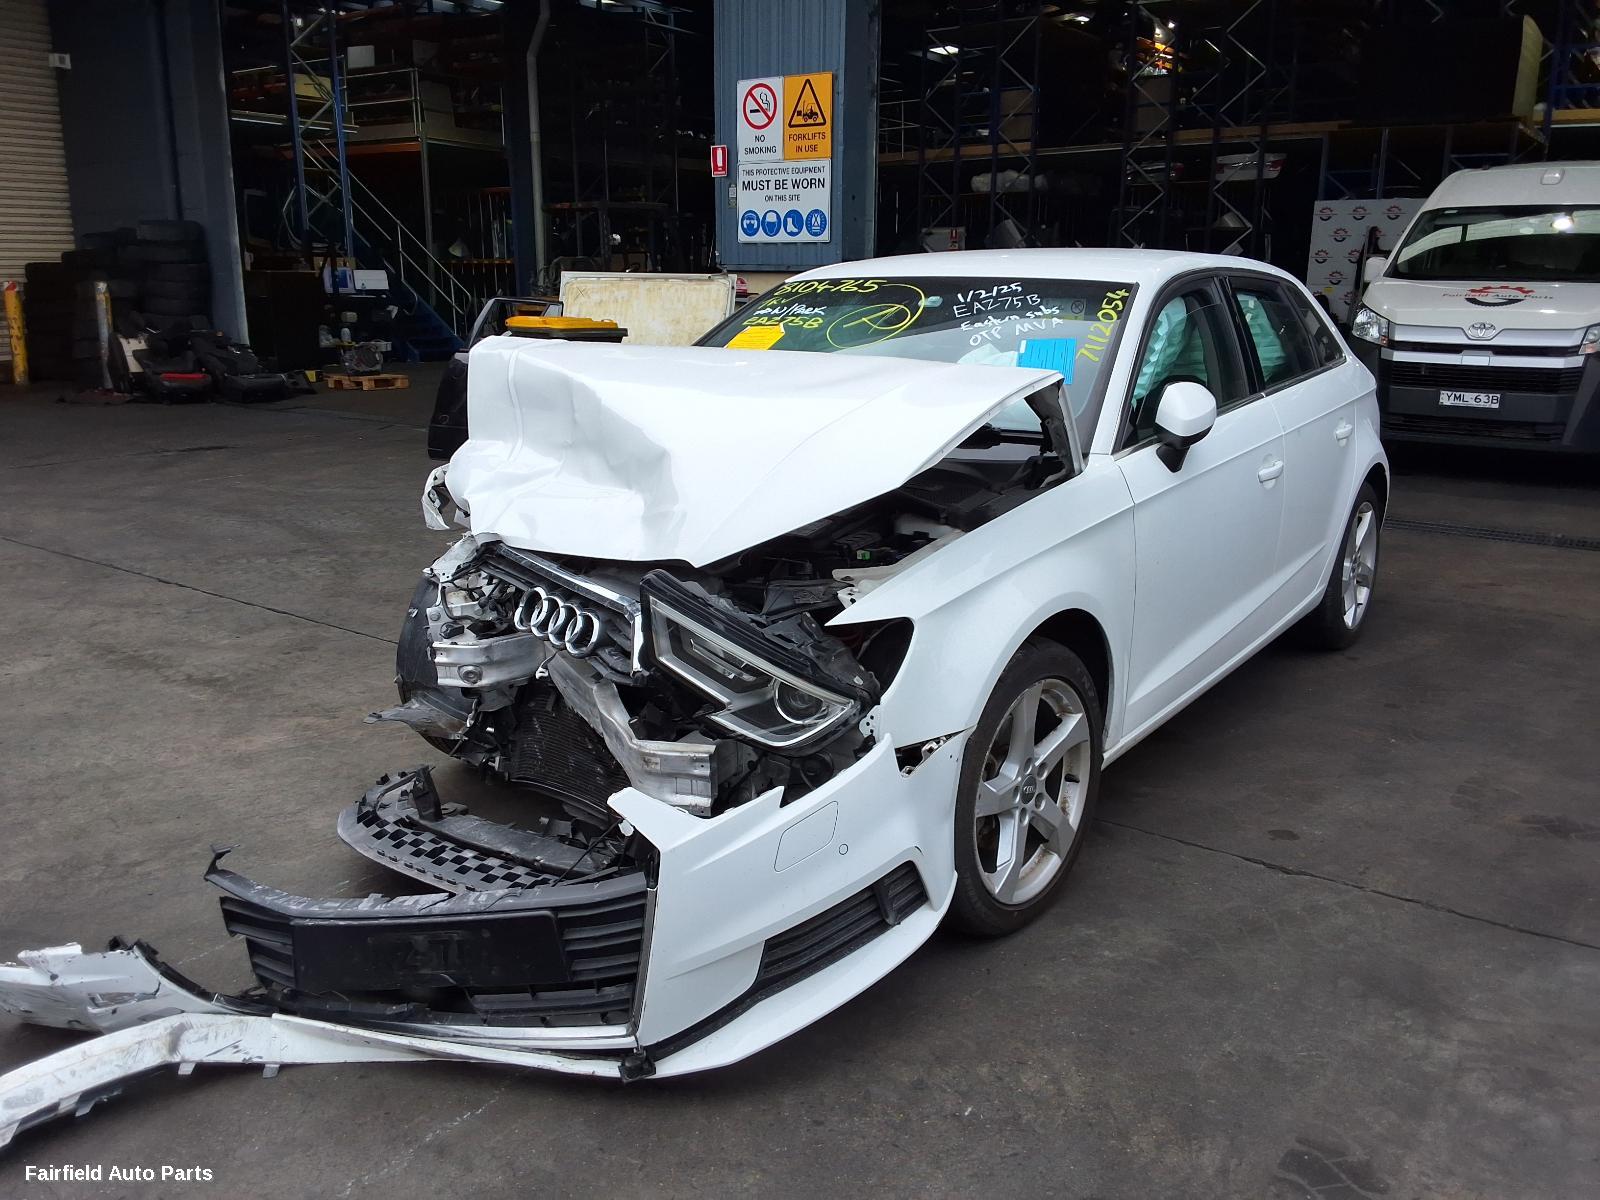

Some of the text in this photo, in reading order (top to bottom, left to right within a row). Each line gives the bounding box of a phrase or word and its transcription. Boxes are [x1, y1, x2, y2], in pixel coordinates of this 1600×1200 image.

[754, 134, 766, 143] NO
[788, 132, 826, 142] FORKLIFTS
[744, 145, 777, 155] SMOKING
[795, 144, 819, 153] IN USE
[756, 167, 790, 176] PROTECTIVE
[791, 166, 826, 174] EQUIPMENT
[742, 178, 825, 191] MUST BE WORN
[775, 194, 787, 202] THIS
[953, 294, 1041, 318] EAZ75B
[1076, 288, 1131, 362] 7112054
